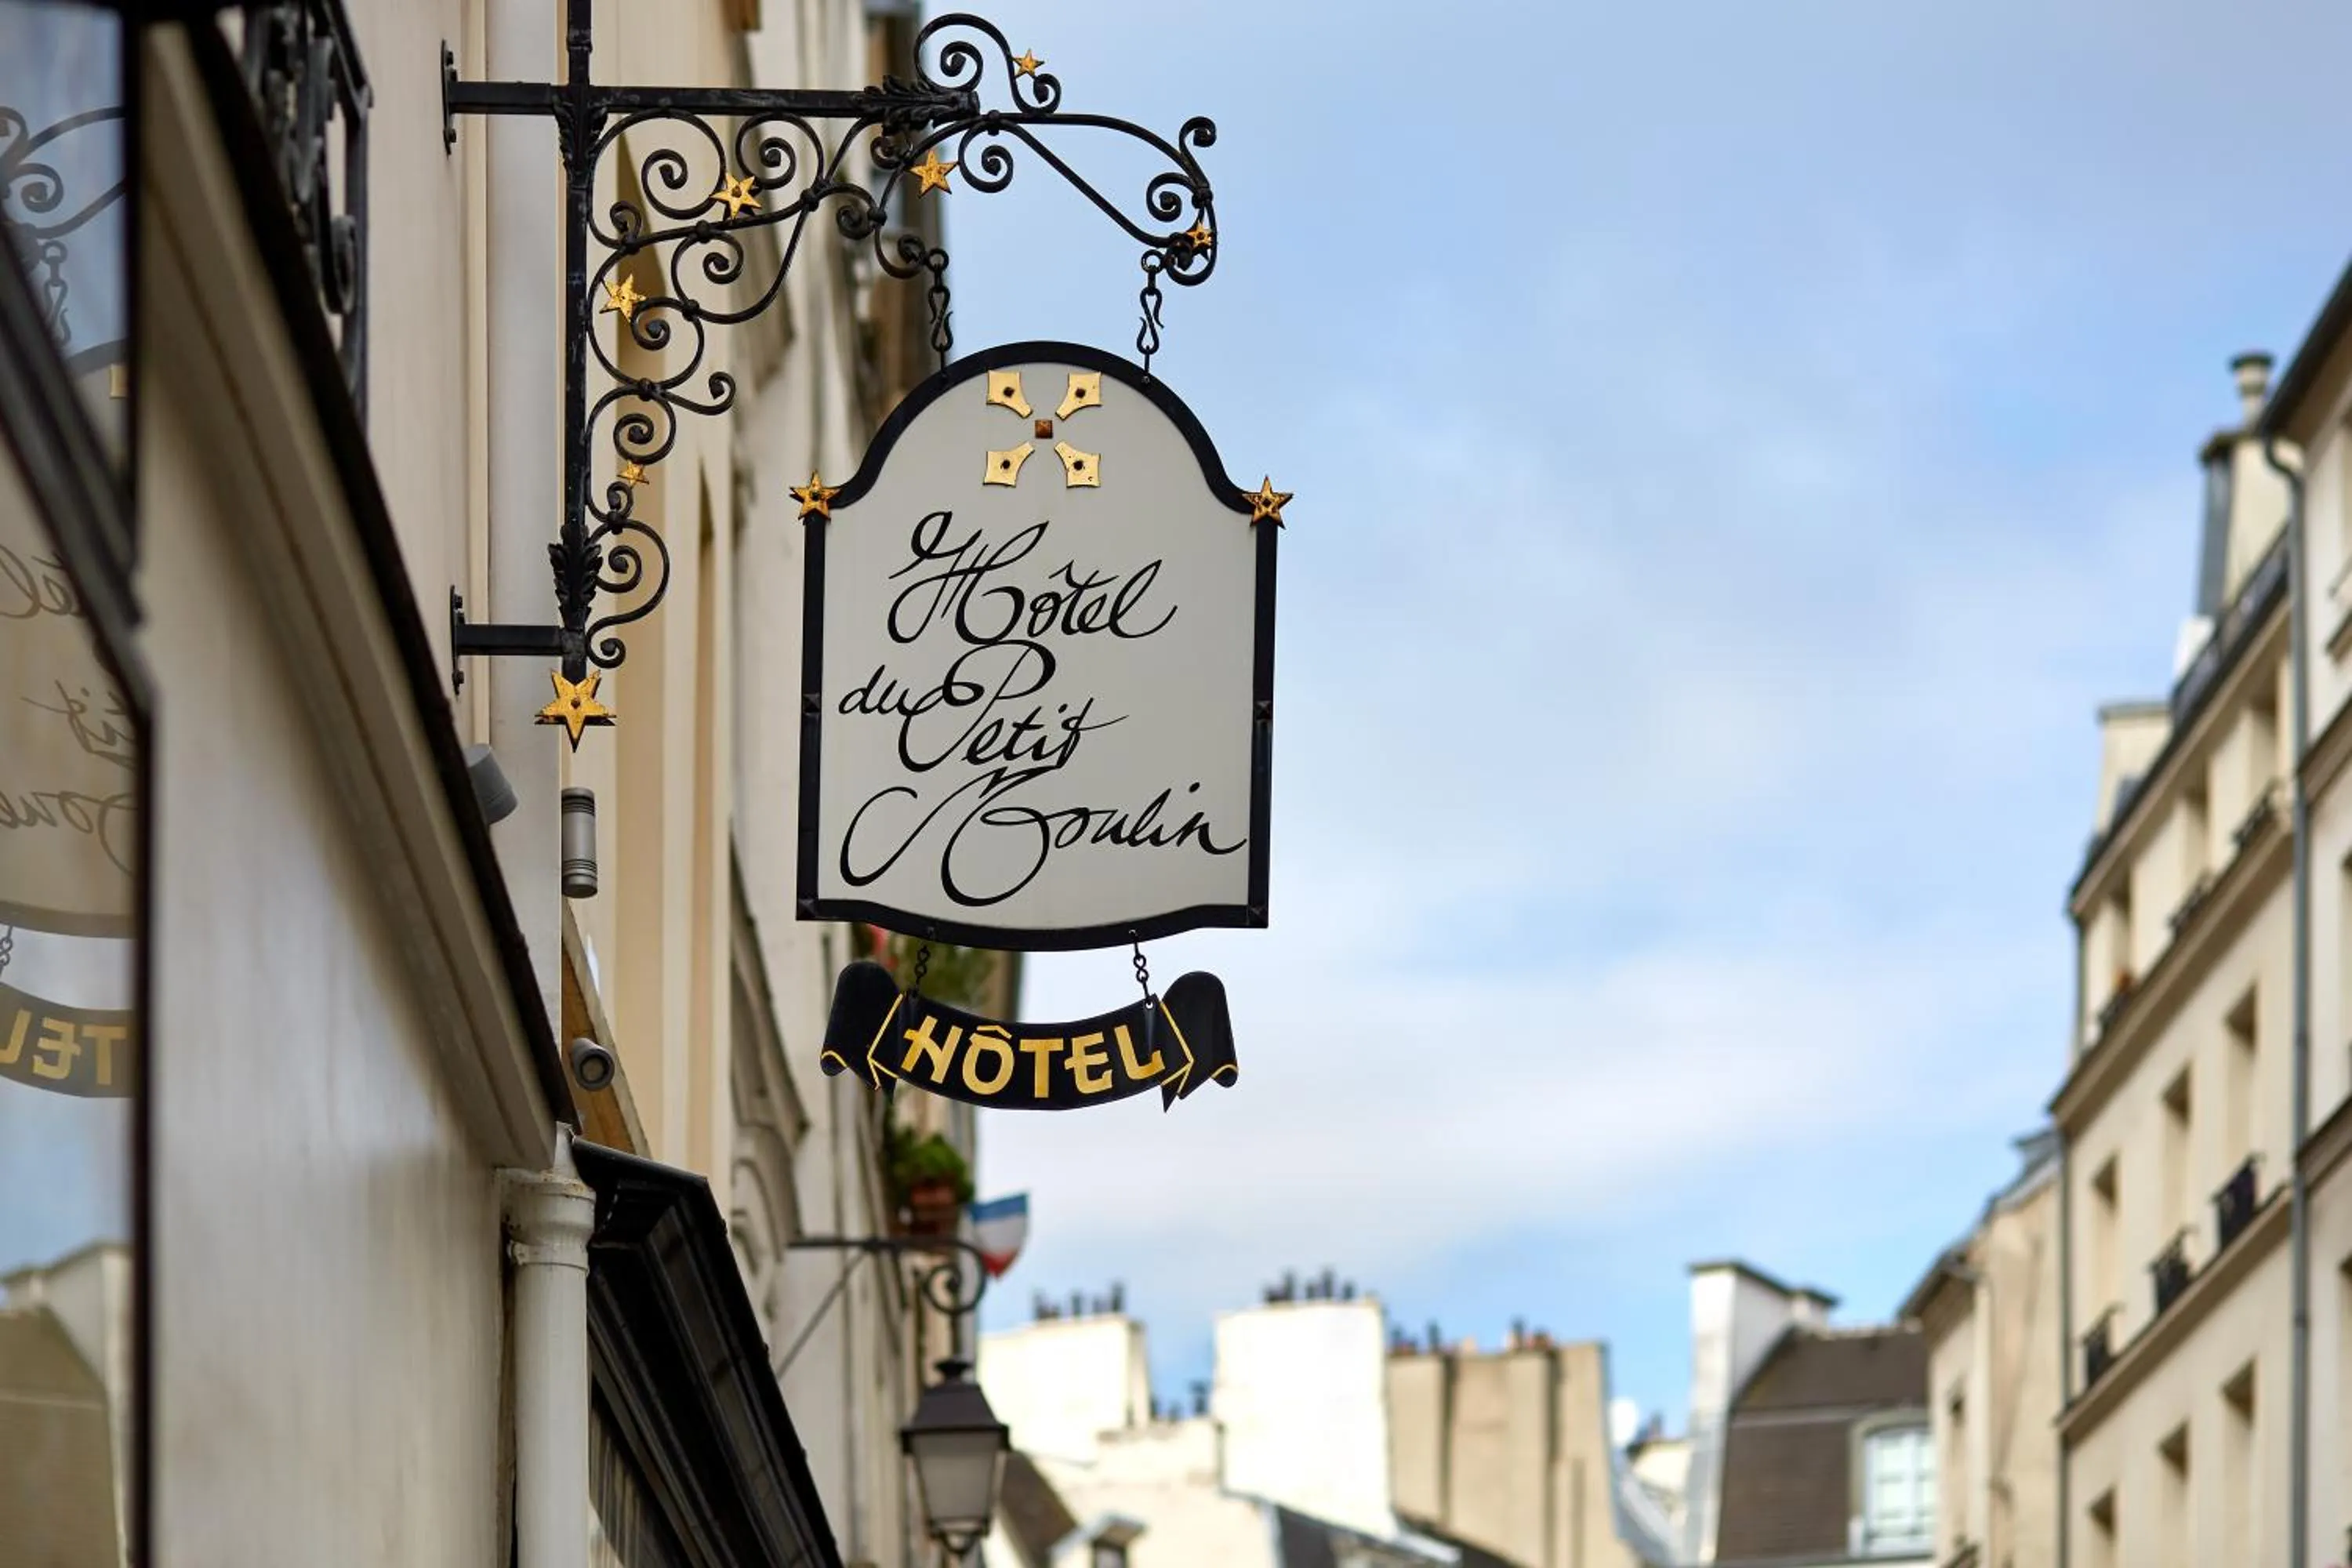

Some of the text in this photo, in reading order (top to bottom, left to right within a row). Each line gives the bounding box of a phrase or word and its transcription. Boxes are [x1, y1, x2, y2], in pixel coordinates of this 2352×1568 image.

[838, 638, 1130, 773] du Petit
[840, 765, 1247, 907] Moulin
[900, 1014, 1167, 1099] HÔTEL
